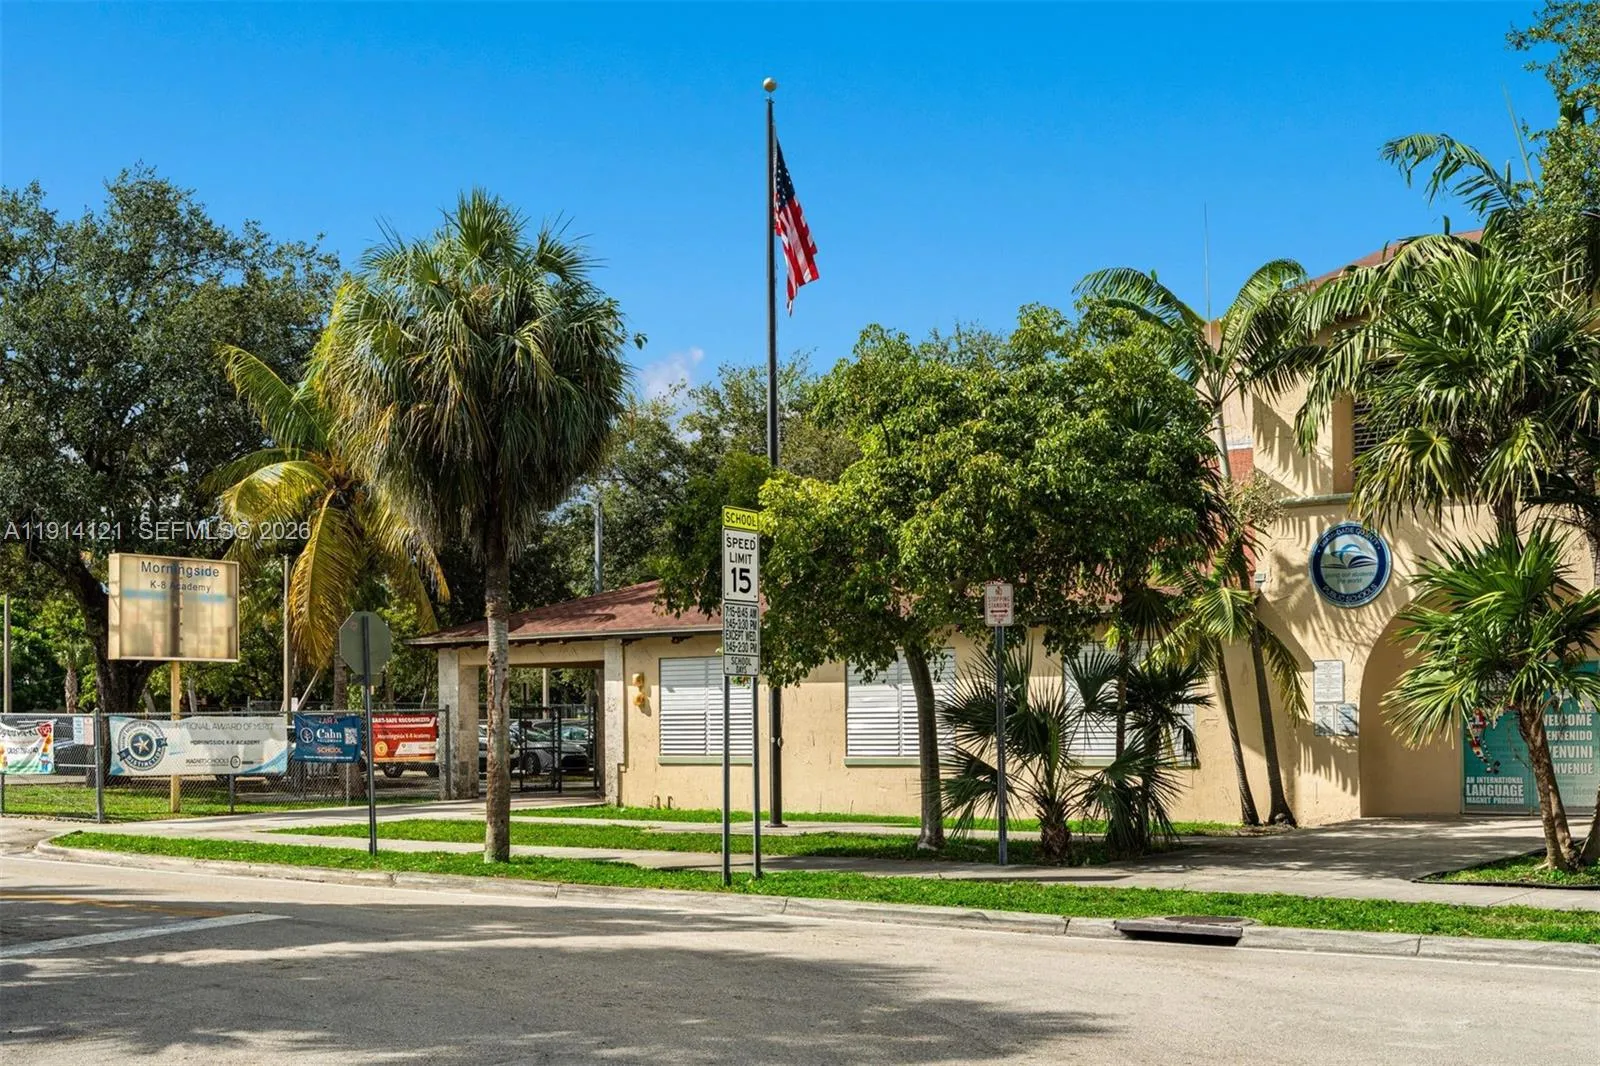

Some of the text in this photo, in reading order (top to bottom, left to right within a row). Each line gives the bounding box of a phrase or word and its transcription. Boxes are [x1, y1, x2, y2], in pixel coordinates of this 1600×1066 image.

[725, 511, 757, 527] SCHOOL
[726, 536, 756, 551] SPEED
[729, 551, 753, 565] LIMIT
[141, 560, 220, 578] Morningside
[731, 566, 752, 594] 15
[150, 580, 212, 594] K-8 Academy
[749, 607, 758, 619] AM
[749, 619, 758, 631] PM
[725, 629, 744, 641] EXCEPT
[749, 642, 758, 654] PM
[731, 656, 752, 666] SCHOOL
[316, 728, 343, 739] Cahn
[1546, 730, 1593, 741] ENVENIDO
[1550, 745, 1593, 759] ENVINI
[1553, 763, 1593, 774] NVENUE
[1476, 776, 1523, 784] INTERNATIONAL
[1466, 783, 1525, 797] LANGUAGE
[1466, 796, 1525, 805] MAGNET PROGRAM
